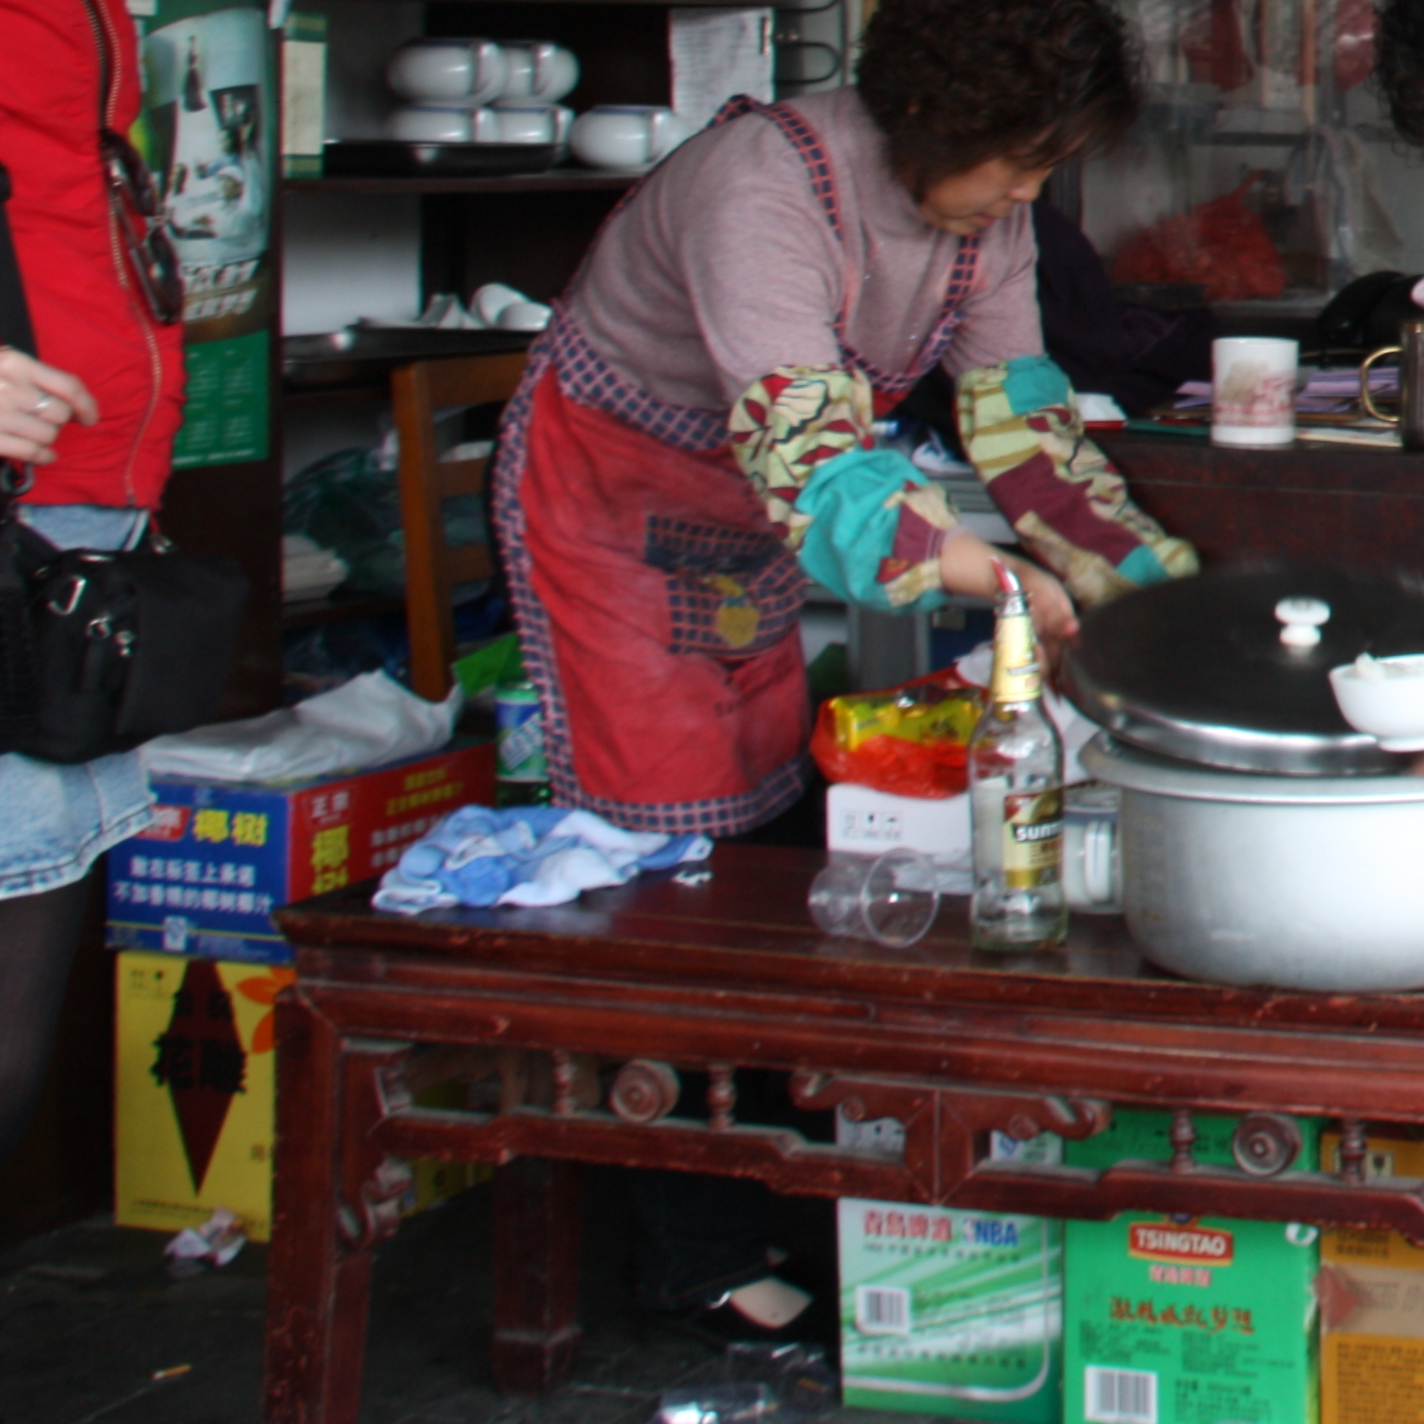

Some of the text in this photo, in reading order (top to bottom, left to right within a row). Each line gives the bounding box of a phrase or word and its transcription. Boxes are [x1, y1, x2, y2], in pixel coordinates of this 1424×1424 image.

[312, 790, 350, 817] 正宗
[192, 808, 268, 847] 椰树
[865, 1210, 1018, 1246] 青岛啤酒 NBA
[1136, 1228, 1227, 1256] TSINGTAO
